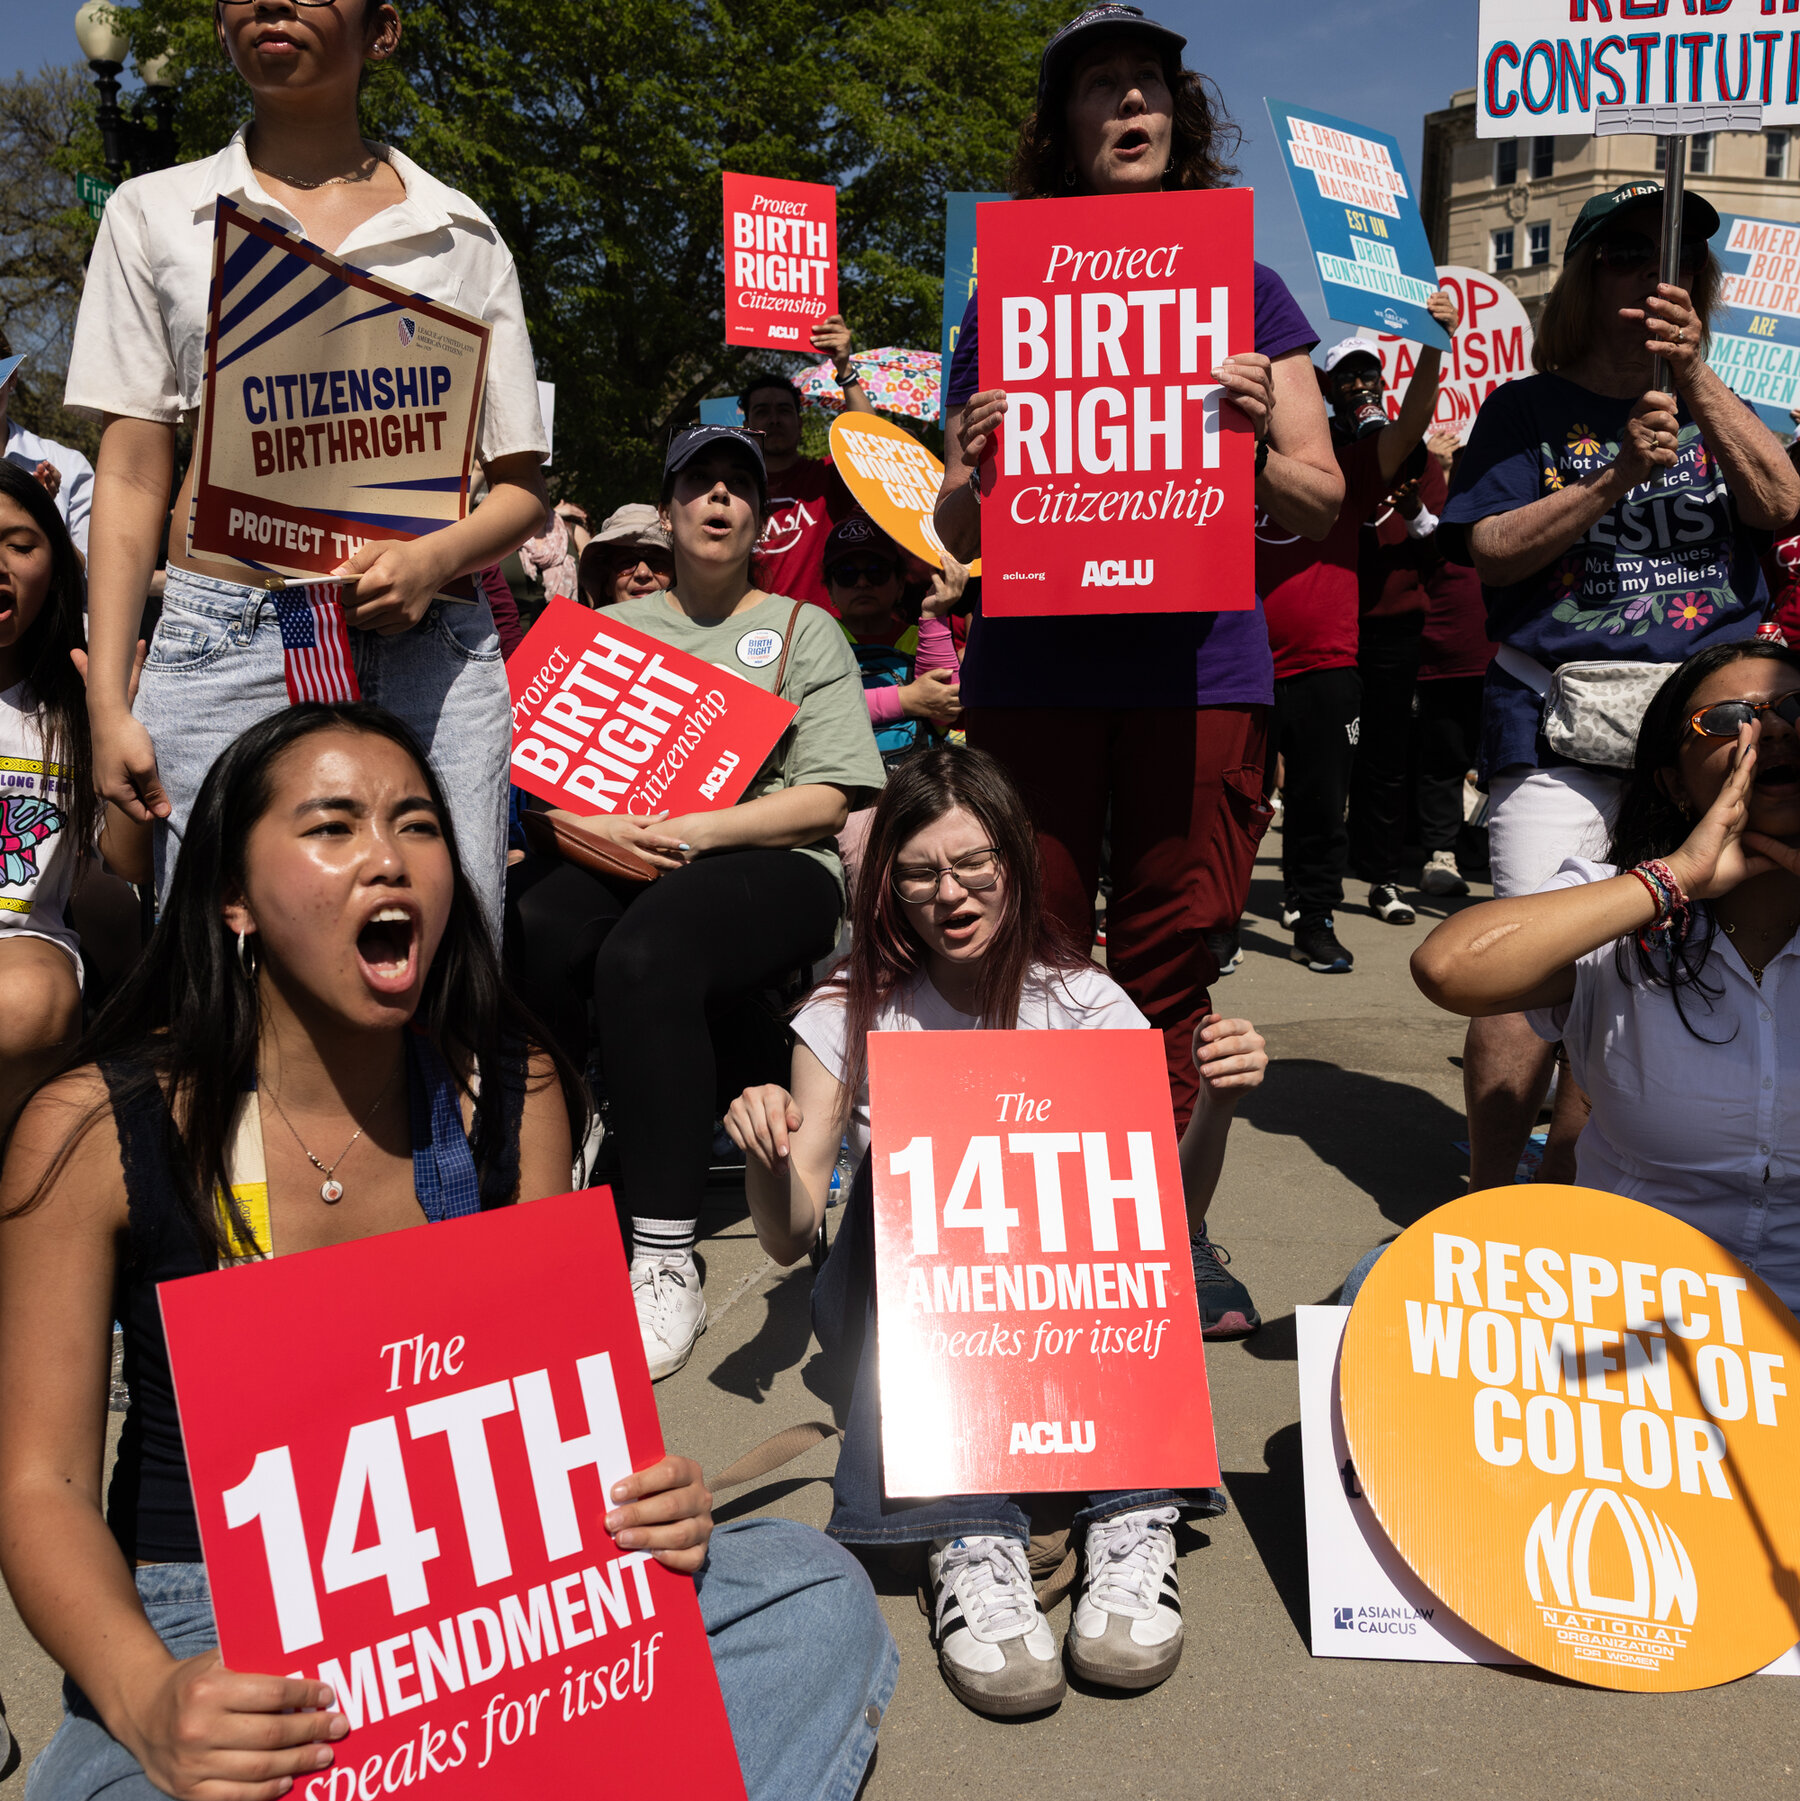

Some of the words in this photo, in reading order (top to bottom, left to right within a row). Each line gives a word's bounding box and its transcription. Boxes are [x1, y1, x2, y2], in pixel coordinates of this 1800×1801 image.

[1291, 119, 1310, 142] LE
[1311, 125, 1355, 155] DROIT
[1371, 143, 1390, 167] LA
[1292, 143, 1384, 187] CITOYENNETÉ
[1385, 171, 1403, 194] DE
[751, 194, 808, 217] Protect
[1318, 174, 1396, 214] NAISSANCE
[734, 212, 827, 257] BIRTH
[1345, 209, 1368, 233] EST
[1369, 215, 1389, 239] UN
[734, 251, 830, 296] RIGHT
[1042, 243, 1184, 283] Protect
[1355, 239, 1394, 269] DROIT
[738, 291, 827, 318] Citizenship
[1748, 315, 1778, 337] ARE
[768, 325, 799, 339] ACLU
[1002, 286, 1229, 381] BIRTH
[242, 366, 451, 424] CITIZENSHIP
[252, 411, 447, 477] BIRTHRIGHT
[838, 428, 934, 470] RESPECT
[1004, 383, 1228, 476] RIGHT
[845, 452, 931, 490] WOMEN
[1560, 456, 1591, 470] Not
[1640, 471, 1694, 492] vice,
[1010, 478, 1224, 527] Citizenship
[228, 508, 324, 555] PROTECT
[331, 532, 374, 560] TH
[1002, 570, 1046, 582] aclu.org
[1081, 559, 1153, 587] ACLU
[1583, 580, 1616, 596] Not
[1622, 577, 1649, 594] my
[1655, 564, 1723, 586] beliefs,
[1585, 556, 1612, 574] Not
[1616, 559, 1643, 574] my
[1649, 548, 1715, 568] values,
[747, 646, 772, 656] RIGHT
[748, 639, 773, 648] BIRTH
[511, 632, 647, 785] BIRTH
[562, 653, 699, 813] RIGHT
[626, 689, 729, 816] Citizenship
[698, 750, 740, 802] ACLU
[995, 1092, 1052, 1123] The
[889, 1131, 1166, 1255] 14TH
[903, 1262, 1170, 1314] AMENDMENT
[1433, 1232, 1747, 1346] RESPECT
[1027, 1321, 1083, 1362] for
[1089, 1319, 1171, 1360] itself
[379, 1333, 465, 1393] The
[1405, 1300, 1672, 1411] WOMEN
[1696, 1344, 1788, 1426] OF
[1009, 1421, 1096, 1455] ACLU
[1473, 1387, 1734, 1500] COLOR
[222, 1351, 637, 1655] 14TH
[1525, 1488, 1698, 1625] NOW
[1358, 1606, 1401, 1619] ASIAN
[1404, 1608, 1434, 1620] LAW
[1358, 1621, 1417, 1635] CAUCUS
[1543, 1611, 1687, 1644] NATIONAL
[285, 1551, 656, 1731] MENDMENT
[1557, 1630, 1674, 1656] ORGANIZATION
[1574, 1647, 1601, 1658] FOR
[1607, 1652, 1660, 1667] WOMEN
[478, 1685, 549, 1768] for
[560, 1631, 664, 1722] itself
